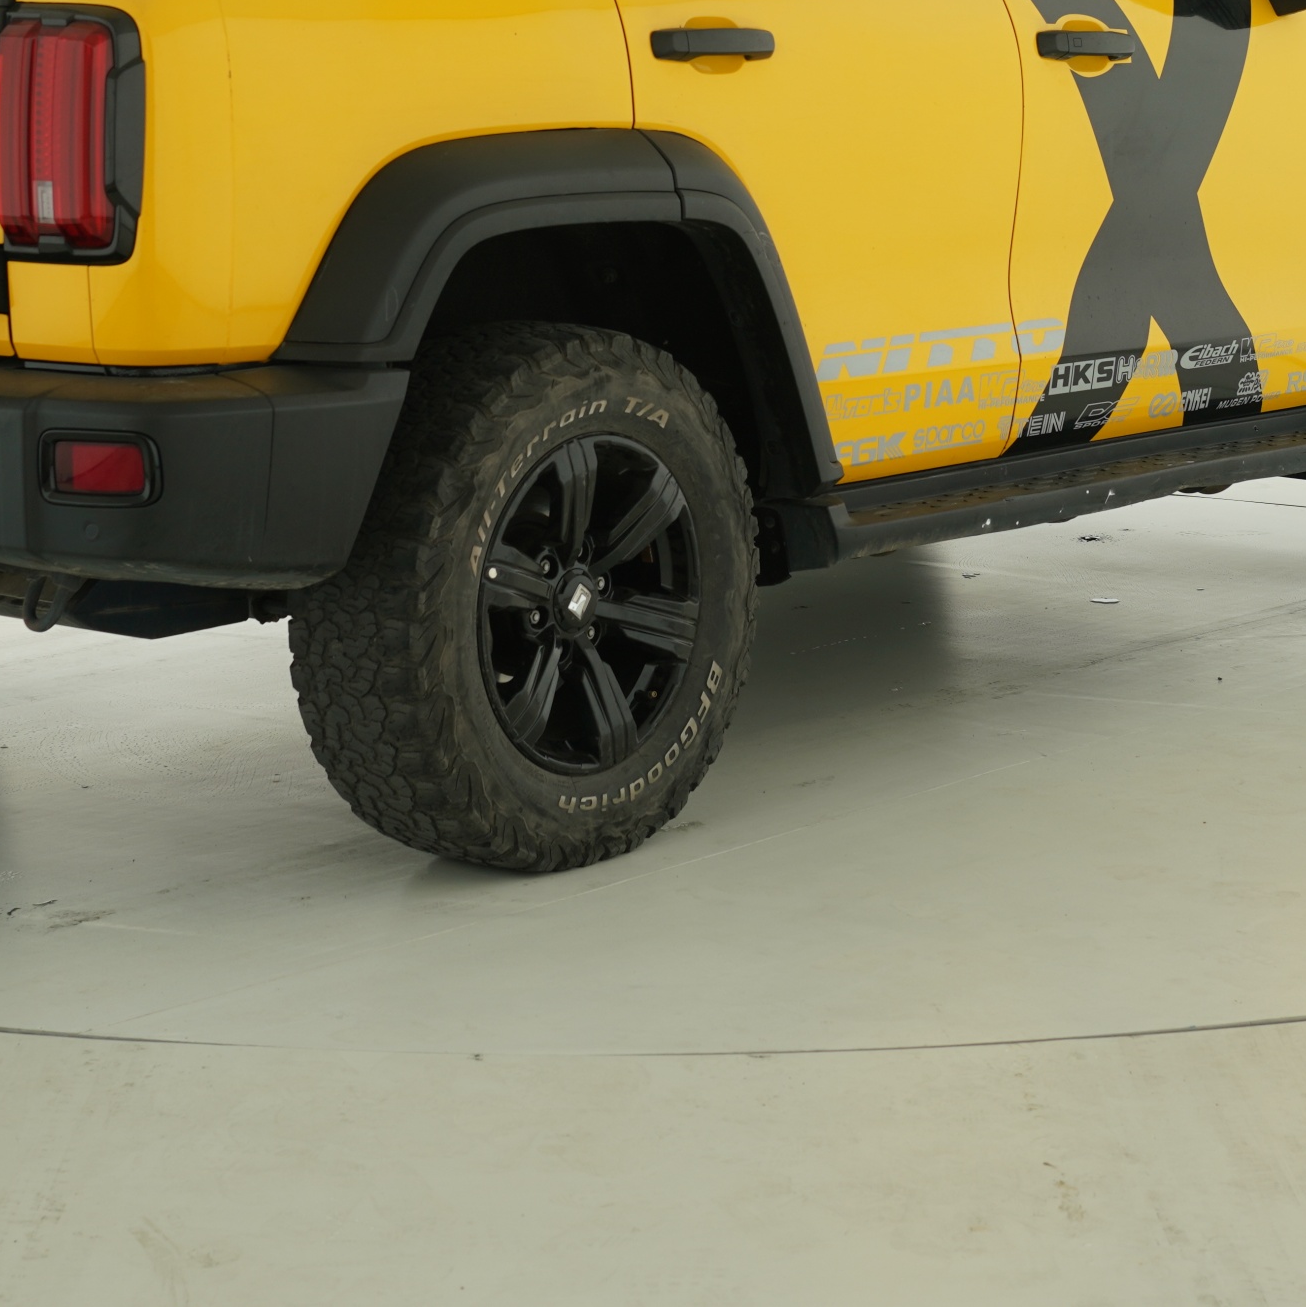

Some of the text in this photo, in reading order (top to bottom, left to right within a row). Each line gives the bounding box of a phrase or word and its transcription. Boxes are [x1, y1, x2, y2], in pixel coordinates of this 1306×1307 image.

[1180, 340, 1239, 369] Eibach
[1194, 356, 1231, 368] FEDERN
[1050, 358, 1115, 393] HKS
[903, 376, 975, 412] PIAA
[1178, 387, 1212, 412] ENKEI
[1216, 396, 1251, 410] MUGEN
[912, 419, 986, 453] sparco
[469, 395, 671, 579] All-Terrain T/A
[559, 660, 724, 814] BFGoodrich
